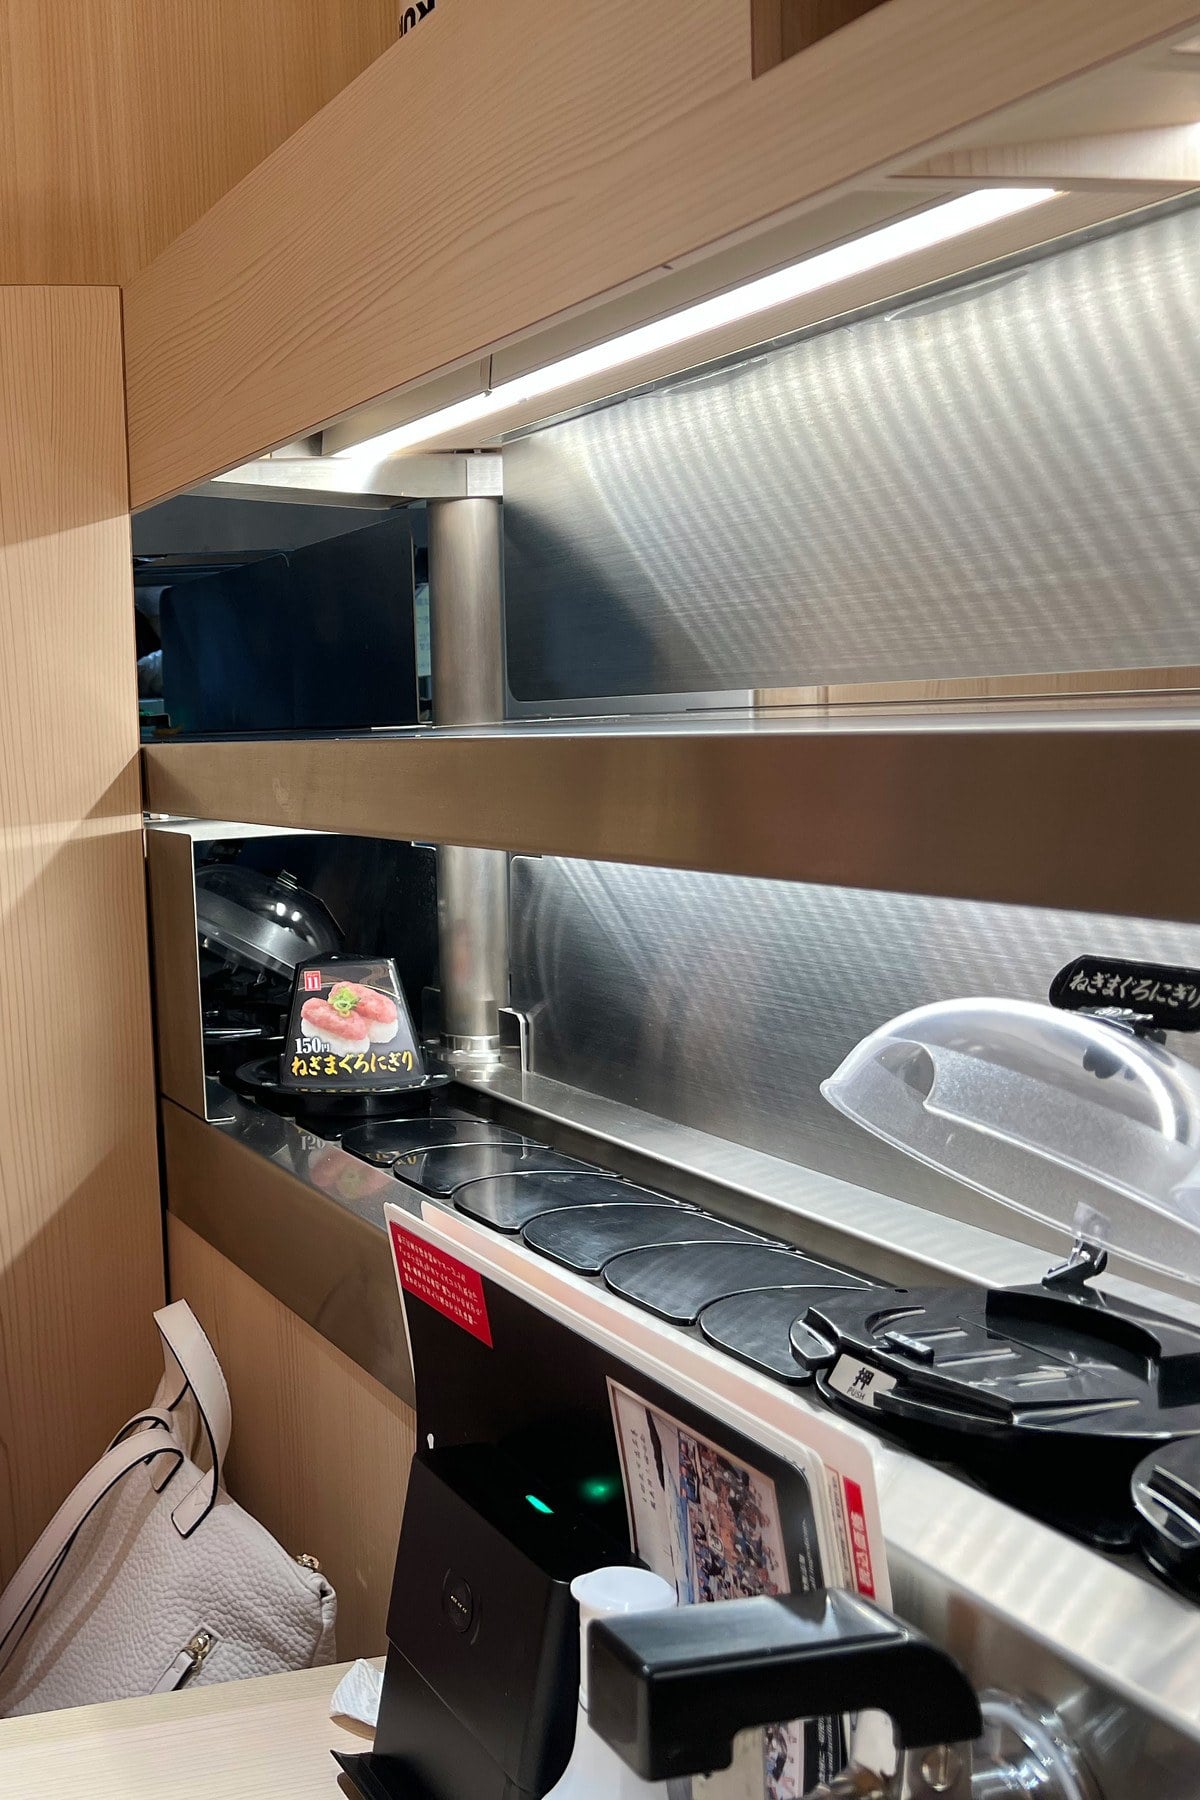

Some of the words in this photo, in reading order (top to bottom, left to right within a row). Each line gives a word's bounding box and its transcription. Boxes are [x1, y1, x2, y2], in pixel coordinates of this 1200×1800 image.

[1069, 970, 1200, 1008] ねぎまぐろにぎり
[291, 1051, 413, 1077] ねぎまぐろにぎり
[852, 1367, 875, 1391] 押
[846, 1386, 866, 1401] PUSH
